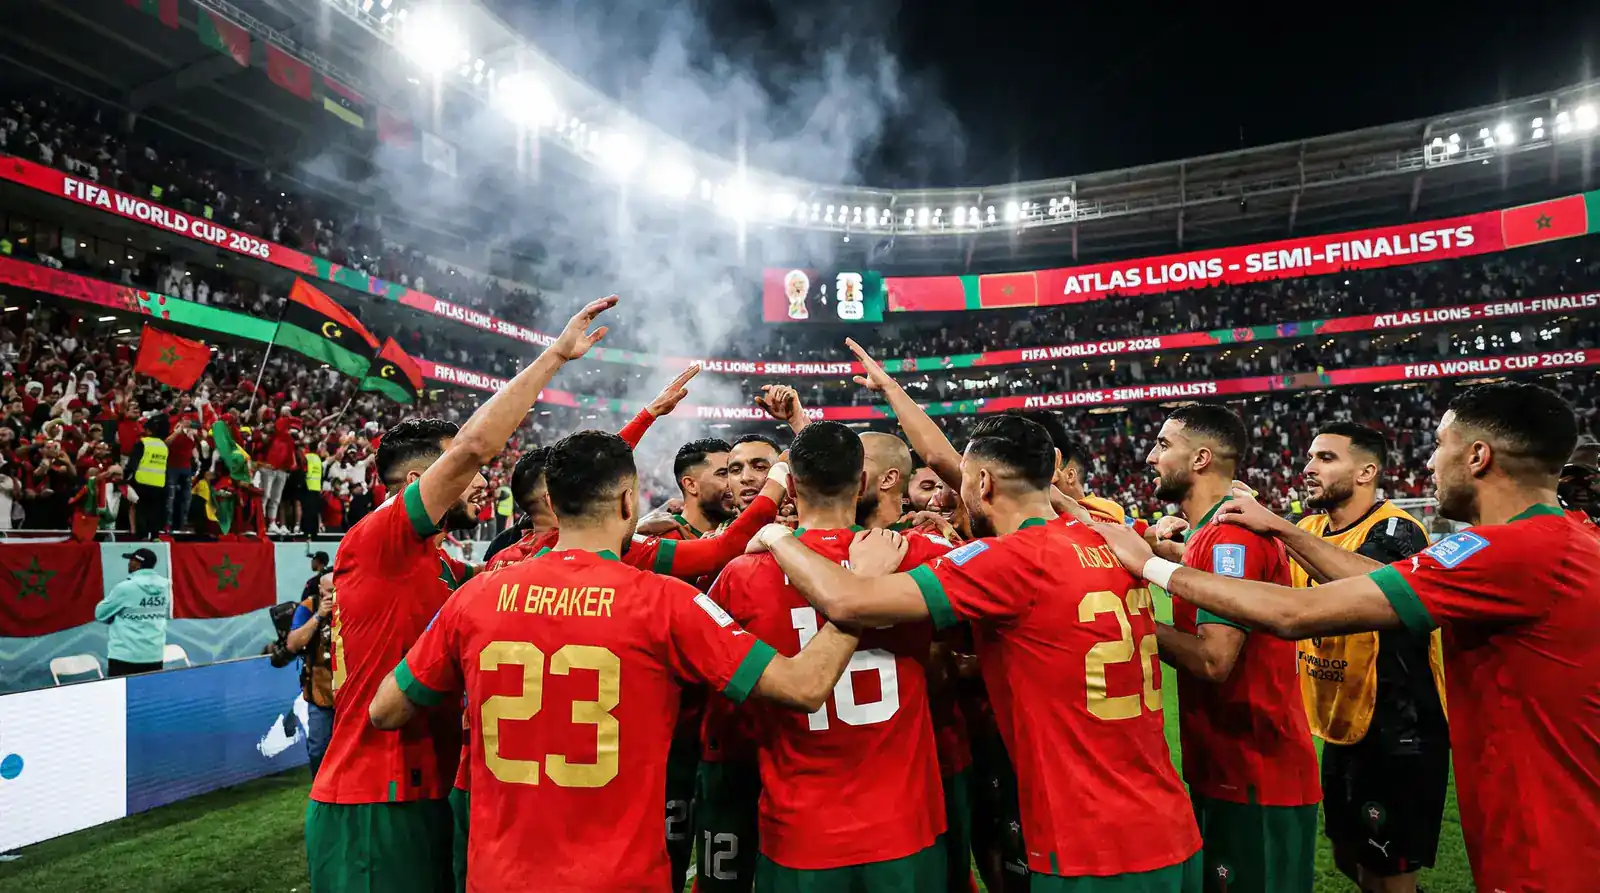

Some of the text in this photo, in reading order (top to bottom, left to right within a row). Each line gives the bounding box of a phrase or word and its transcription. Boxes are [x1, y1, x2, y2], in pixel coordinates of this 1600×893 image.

[64, 177, 270, 258] FIFA WORLD CUP 2026
[1064, 268, 1142, 295] ATLAS
[1146, 257, 1223, 285] LIONS
[1245, 225, 1475, 273] SEMI-FINALISTS
[434, 300, 464, 320] ATLAS
[465, 311, 492, 329] LIONS
[497, 321, 557, 347] SEMI-FINALIST
[1374, 313, 1422, 328] ATLAS
[1424, 307, 1471, 322] LIONS
[1021, 338, 1161, 360] FIFA WORLD CUP 2026
[434, 365, 455, 381] FIFA
[456, 371, 490, 389] WORLD
[724, 362, 756, 373] LIONS
[765, 363, 852, 374] SEMI-FINALISTS
[1404, 351, 1586, 378] FIFA WORLD CUP 2026
[1024, 395, 1063, 408] ATLAS
[1065, 390, 1103, 405] LIONS
[1112, 382, 1217, 401] SEMI-FINALISTS
[697, 407, 720, 418] FIFA
[722, 407, 763, 419] WORLD
[496, 583, 615, 617] M. BRAKER
[480, 641, 621, 788] 23
[704, 829, 739, 880] 12
